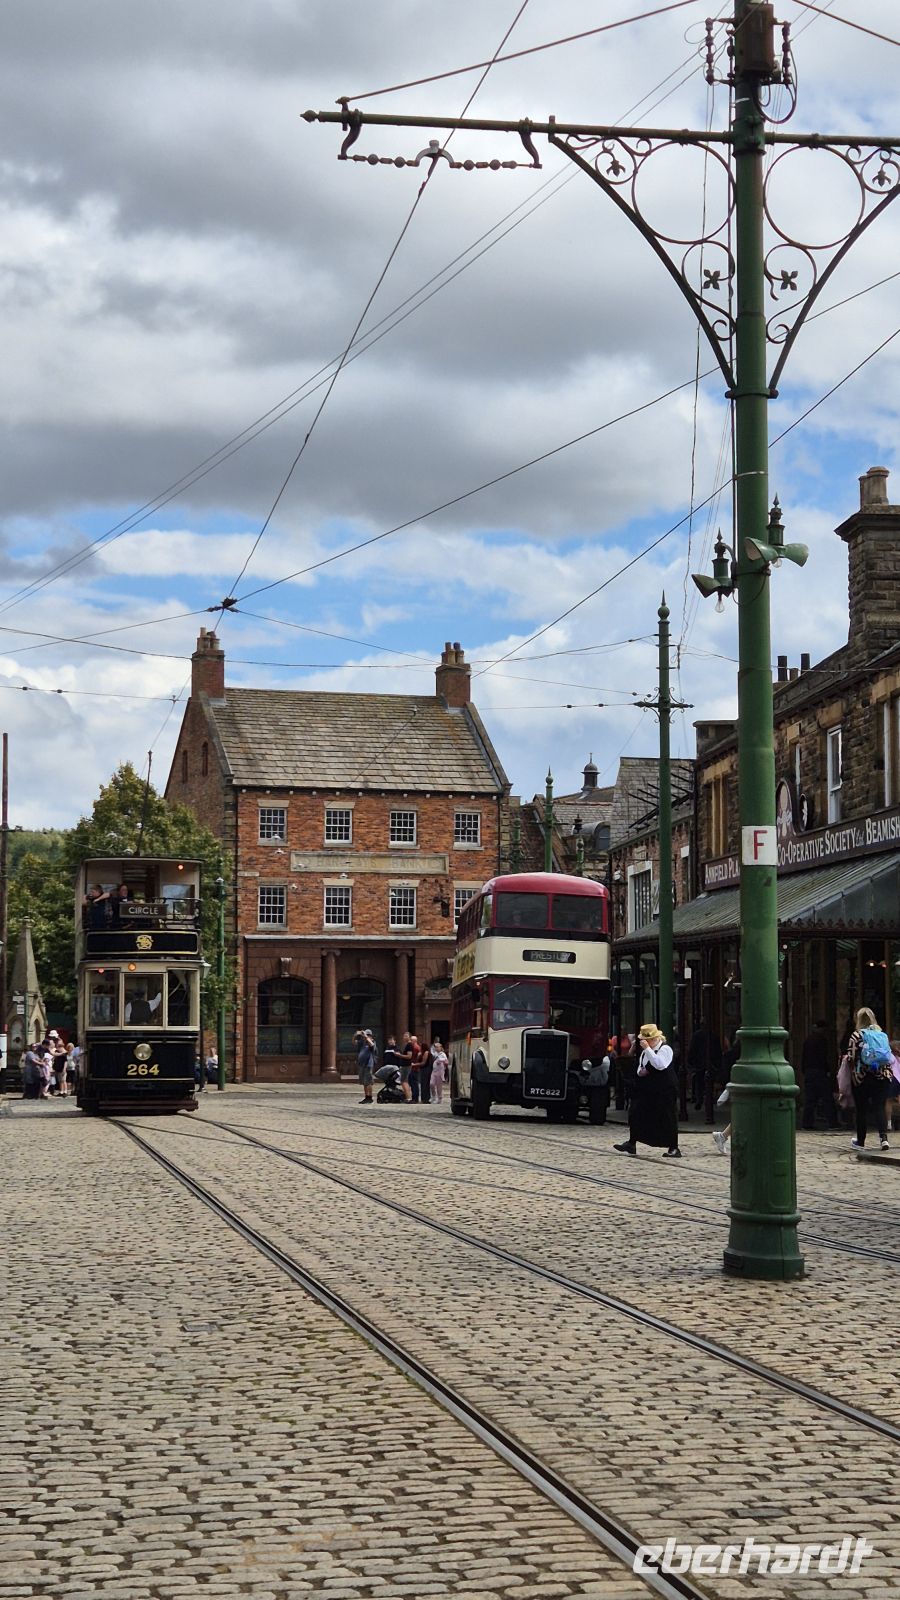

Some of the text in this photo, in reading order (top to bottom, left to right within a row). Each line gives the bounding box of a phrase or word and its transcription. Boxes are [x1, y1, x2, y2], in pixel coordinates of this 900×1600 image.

[753, 829, 768, 861] F
[777, 837, 824, 867] CO-OPERATIVE
[825, 827, 857, 854] SOCIETY
[865, 816, 900, 845] BEAMISH
[391, 858, 426, 869] BANK
[128, 906, 159, 915] CIRCLE
[127, 1063, 160, 1076] 264
[530, 1087, 561, 1096] RTC 822
